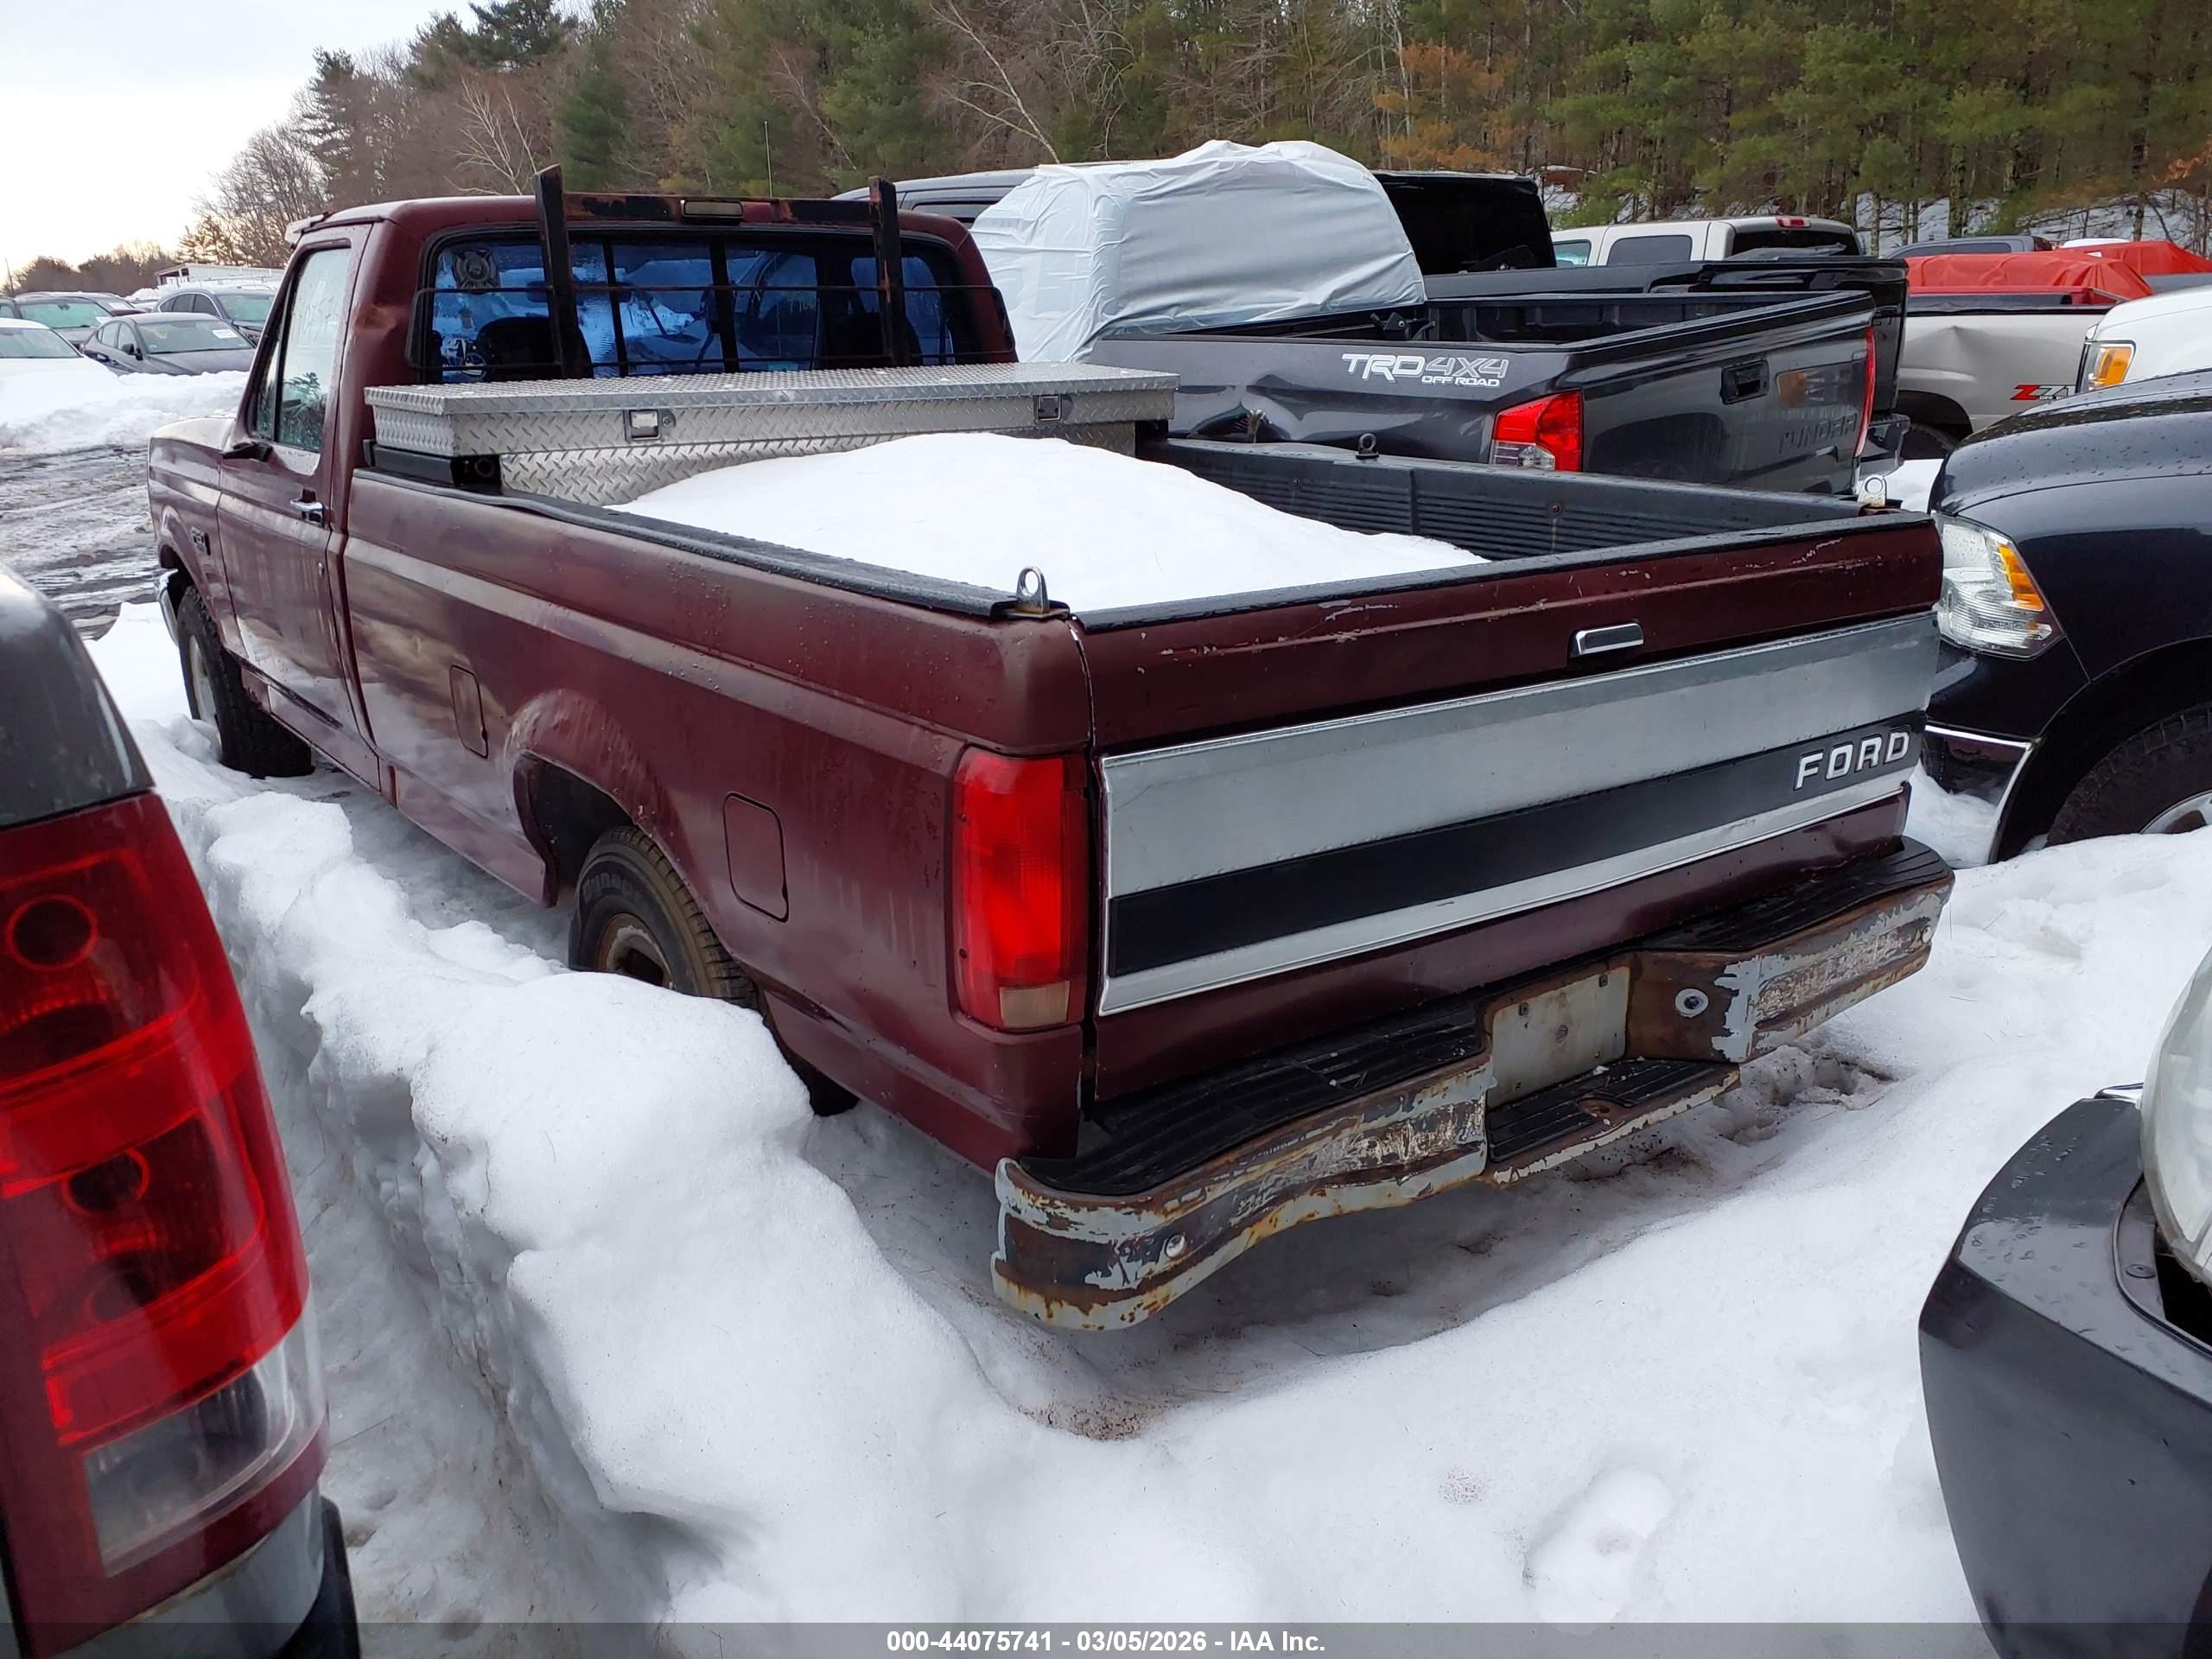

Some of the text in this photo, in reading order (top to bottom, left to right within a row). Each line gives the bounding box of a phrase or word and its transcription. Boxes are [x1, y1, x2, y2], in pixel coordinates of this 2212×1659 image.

[1341, 353, 1425, 382] TRD
[1421, 375, 1500, 387] OFF ROAD
[1794, 731, 1910, 790] FORD
